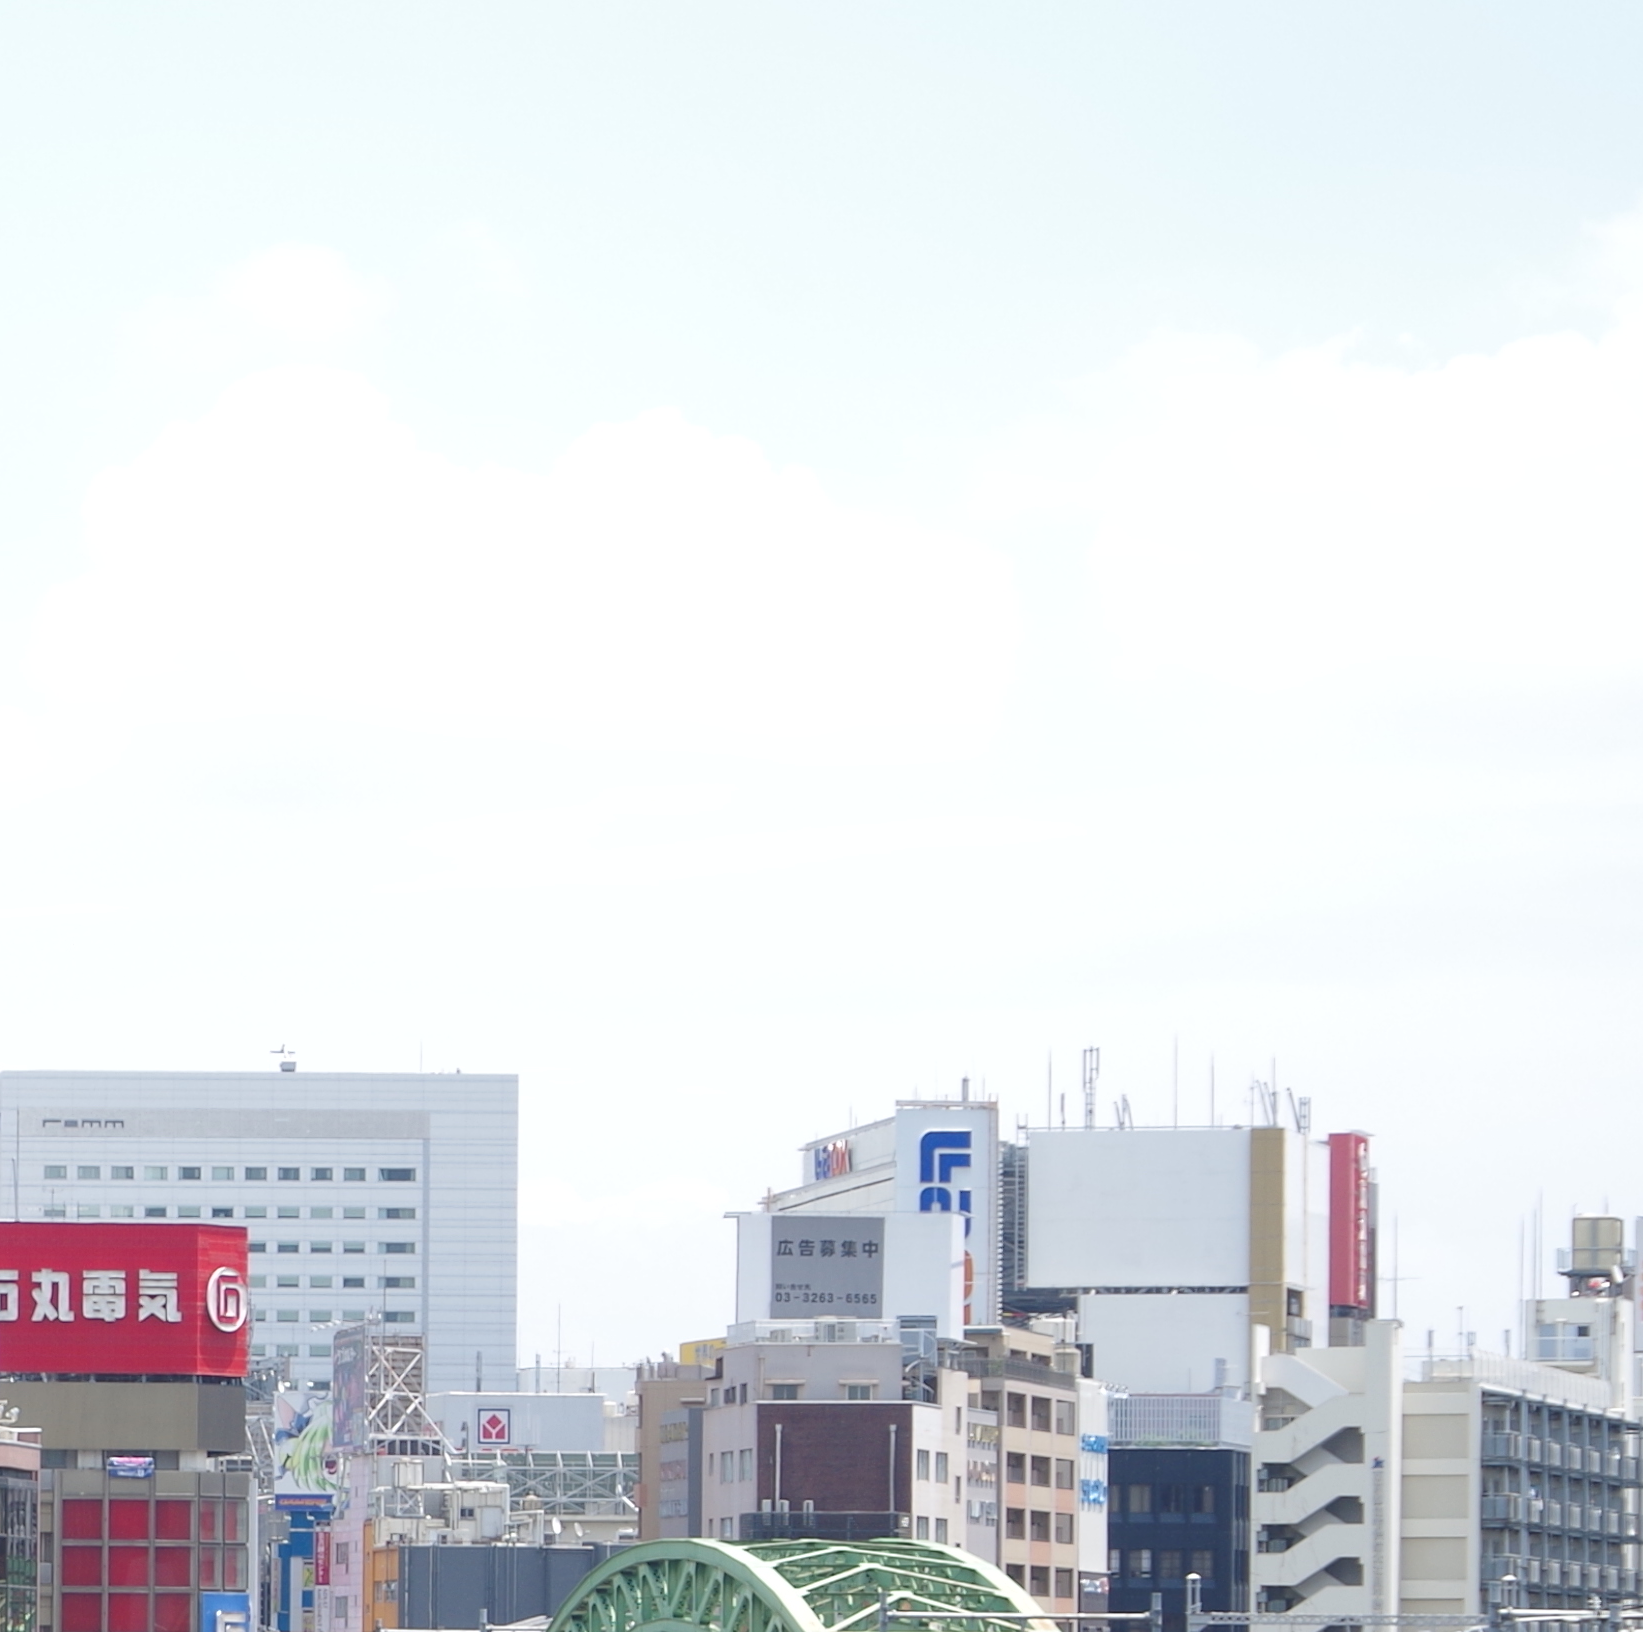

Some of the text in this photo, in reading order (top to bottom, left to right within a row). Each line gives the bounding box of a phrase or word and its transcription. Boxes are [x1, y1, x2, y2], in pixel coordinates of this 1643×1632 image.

[776, 1239, 879, 1259] 広告募集中
[775, 1292, 878, 1305] 03-3263-6565
